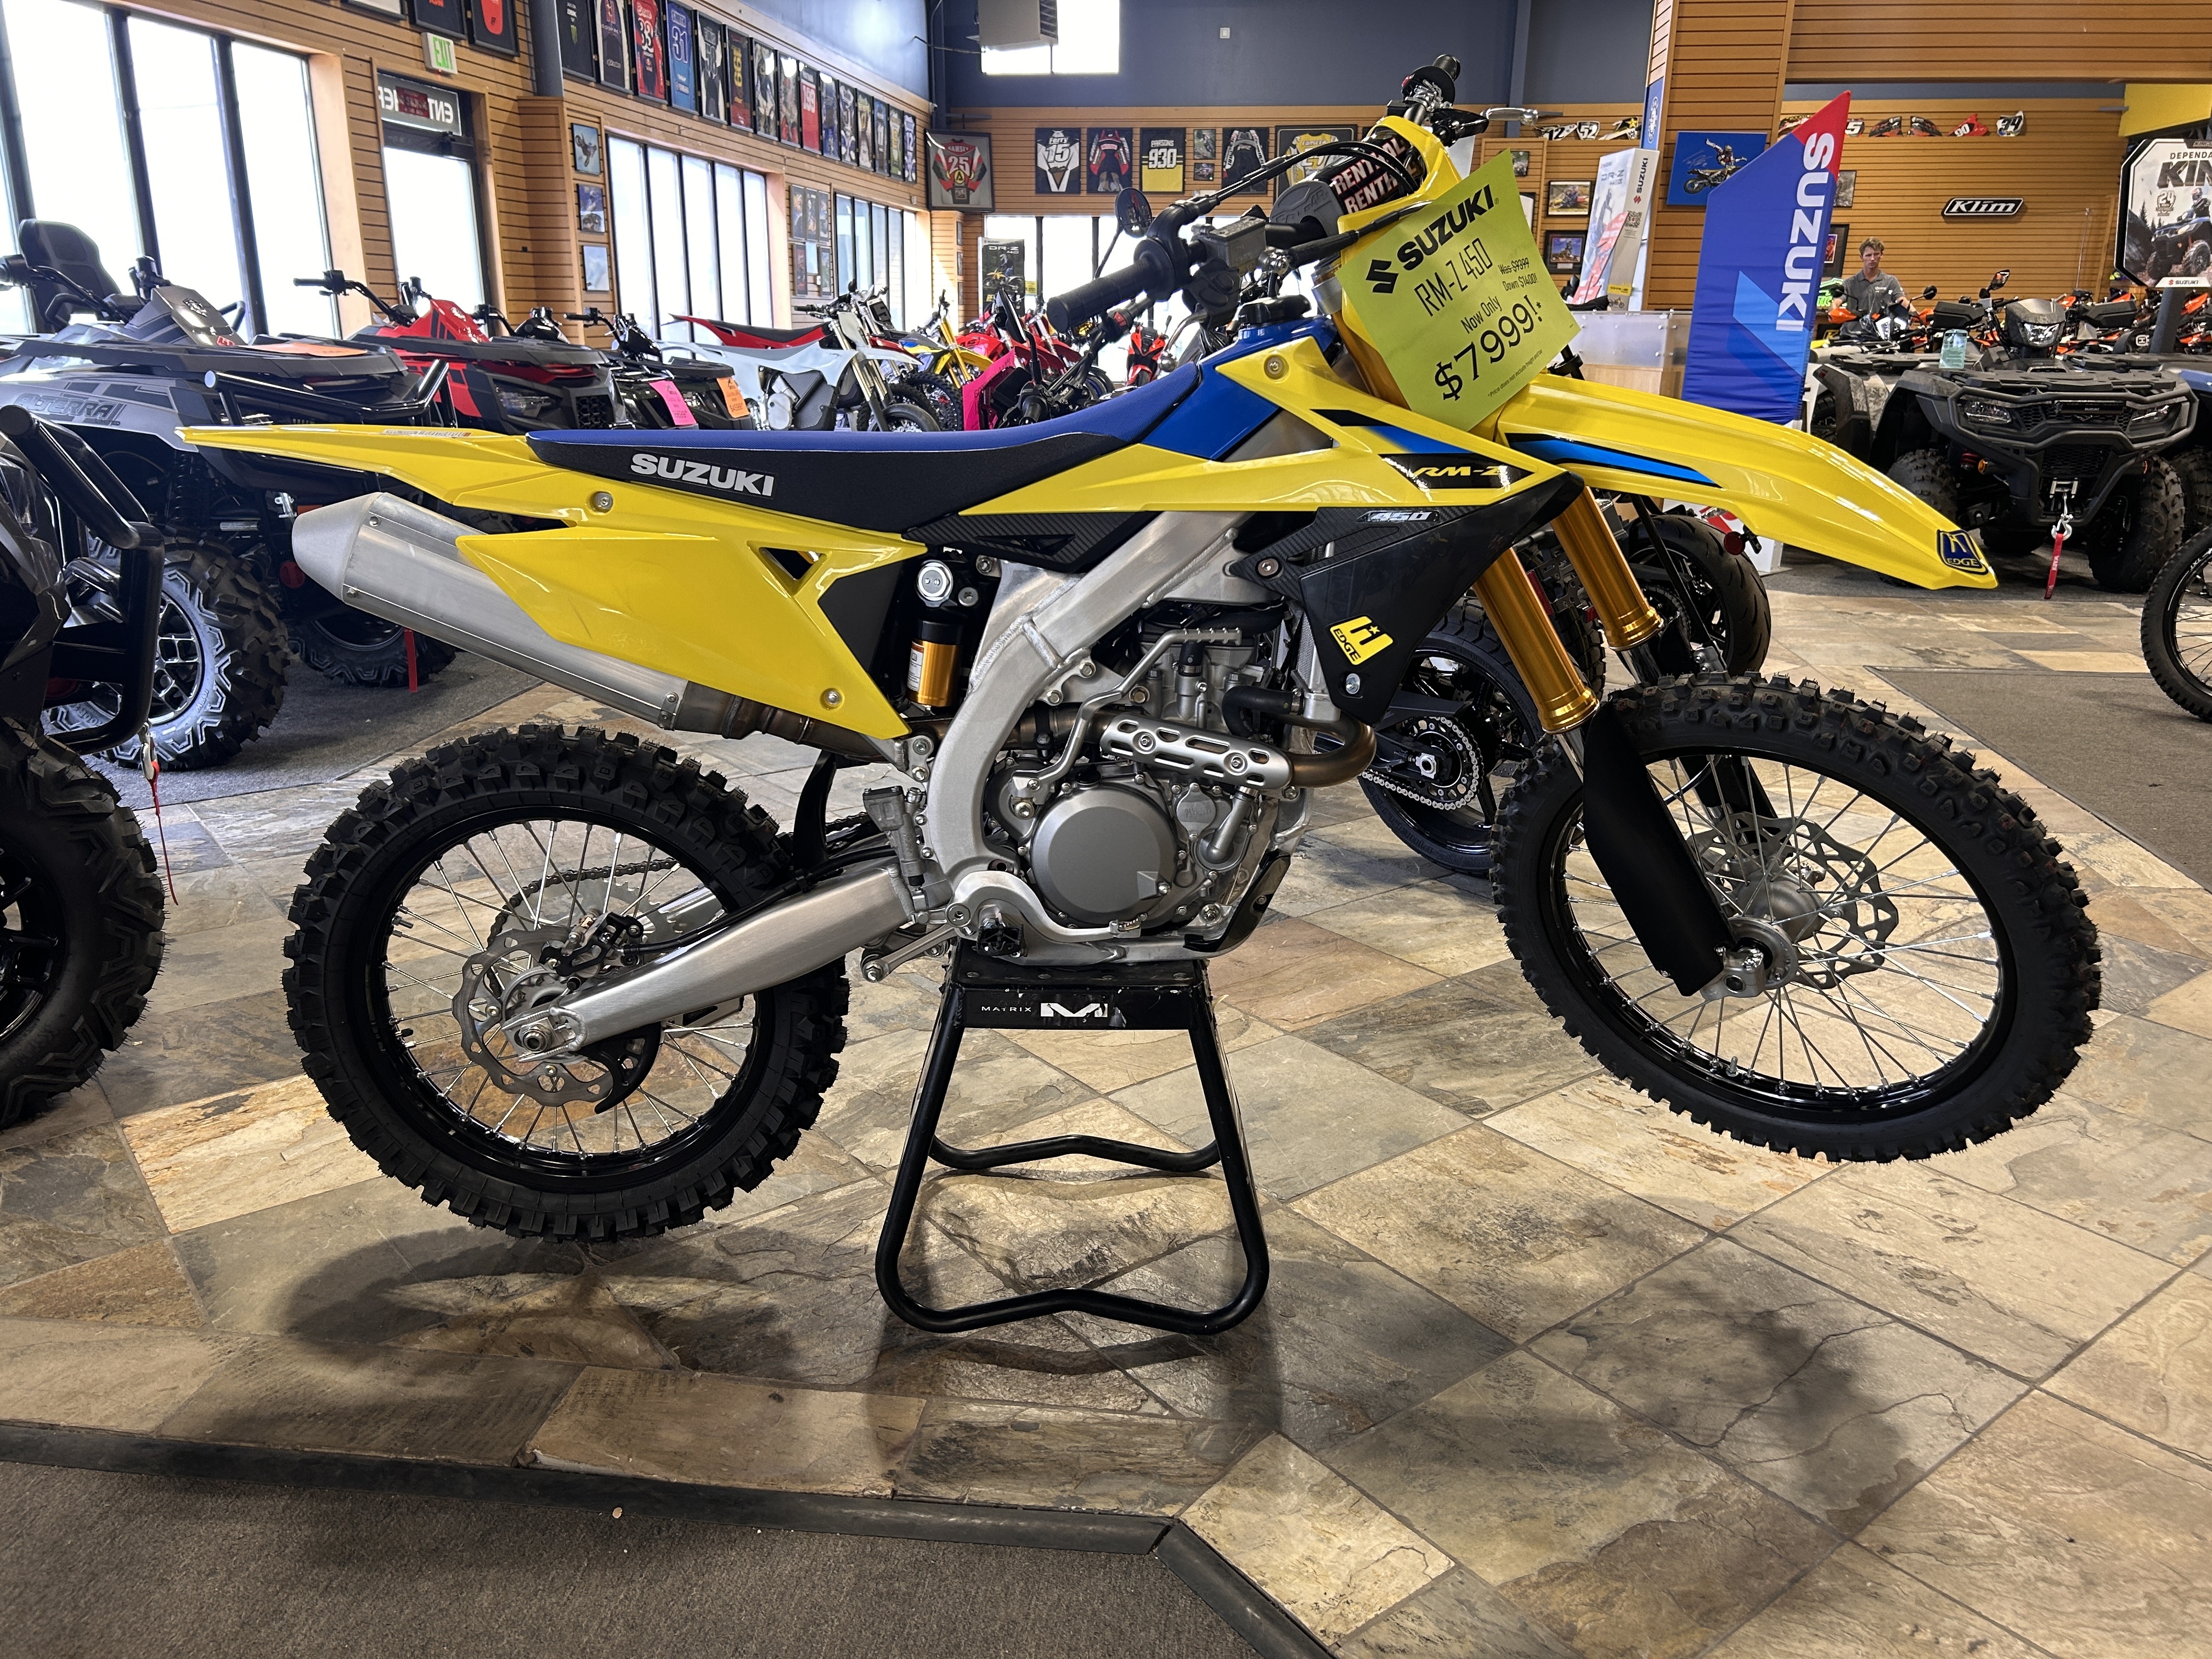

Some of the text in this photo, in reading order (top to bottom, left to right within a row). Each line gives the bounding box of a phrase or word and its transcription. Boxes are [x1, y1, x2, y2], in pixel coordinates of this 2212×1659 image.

[432, 36, 453, 70] EXIT
[1580, 125, 1598, 140] 52
[1954, 123, 1970, 137] 90
[1045, 144, 1070, 163] 15
[1148, 148, 1177, 169] 930
[949, 155, 970, 176] 25
[1636, 157, 1649, 194] SUZUKI
[1397, 184, 1494, 271] SUZUKI
[1775, 132, 1835, 332] SUZUKI
[1414, 237, 1493, 317] RM-Z 450
[1498, 261, 1511, 275] Was
[1502, 272, 1538, 291] Down $1400!
[1460, 296, 1503, 334] Now Only
[13, 393, 117, 419] ALTERRA
[630, 453, 775, 496] SUZUKI
[1371, 511, 1432, 522] 450
[1946, 557, 1980, 567] EDGE
[1333, 628, 1362, 662] EDGE
